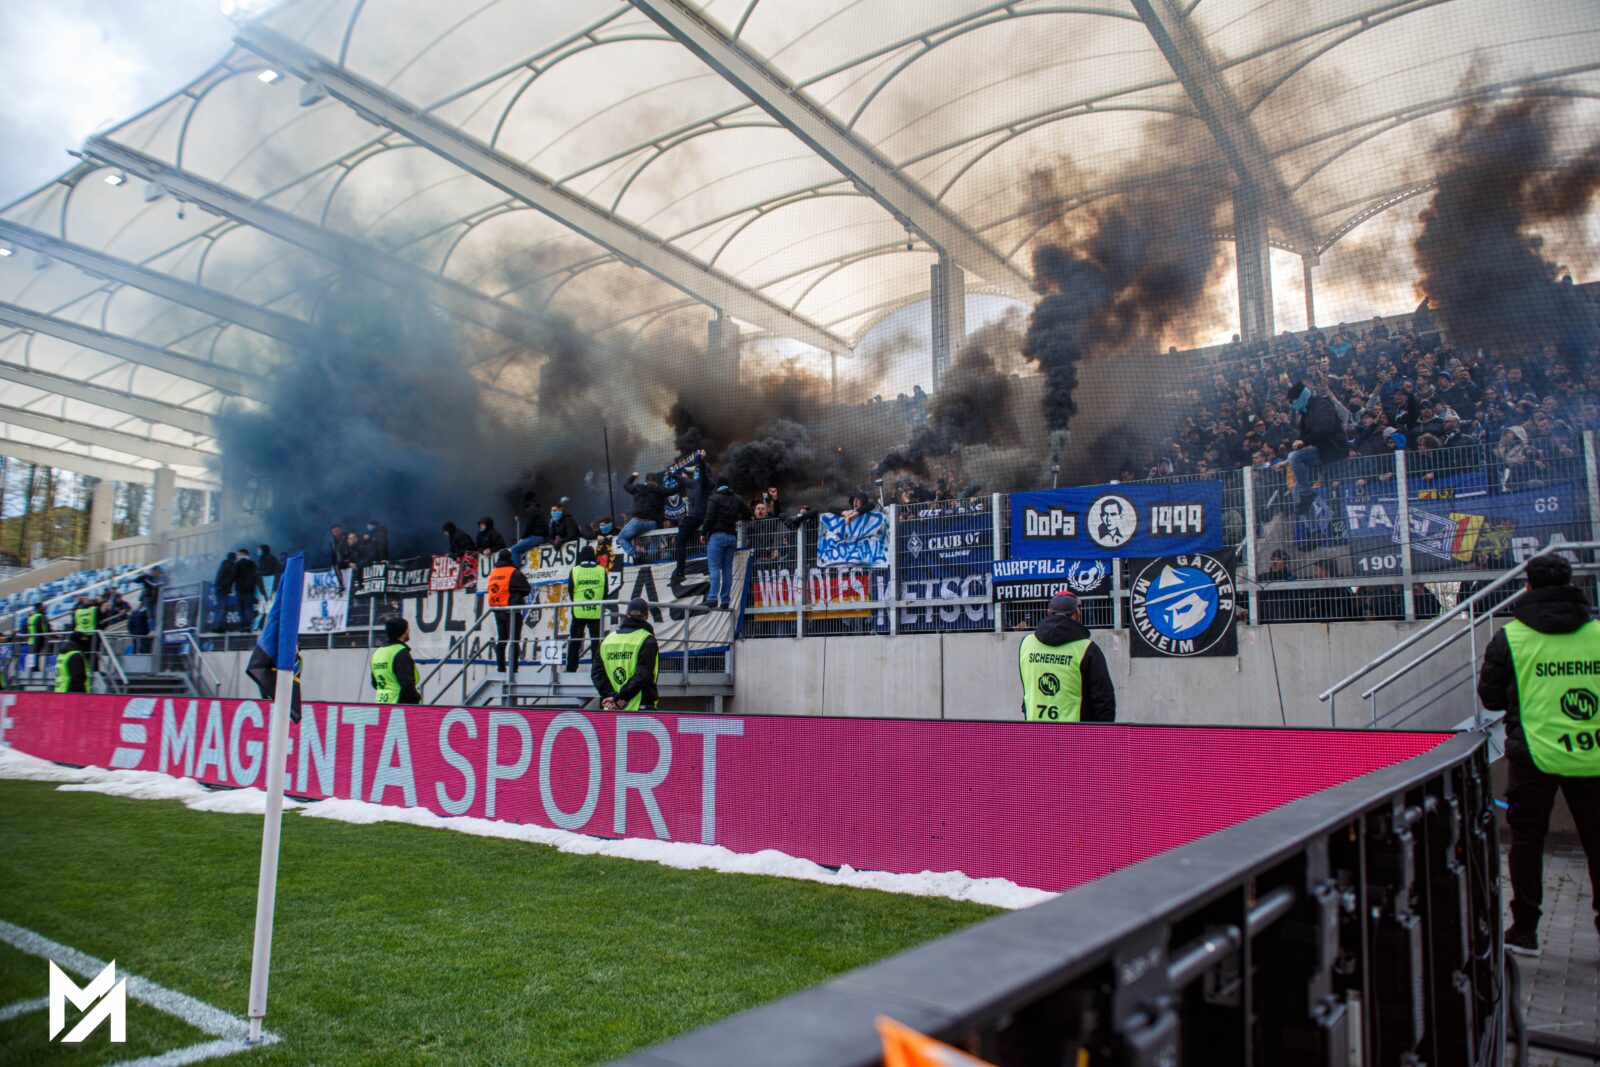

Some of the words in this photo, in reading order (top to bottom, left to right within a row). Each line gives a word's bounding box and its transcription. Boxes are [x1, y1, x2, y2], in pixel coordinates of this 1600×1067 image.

[1026, 508, 1076, 536] DoPa
[1152, 504, 1202, 534] 1999
[927, 534, 962, 550] CLUB
[965, 532, 981, 546] 07
[993, 559, 1066, 577] KURPFALZ
[1176, 555, 1233, 611] GAUNER
[1133, 578, 1194, 654] MANNHEIM
[544, 645, 560, 661] C2
[1029, 652, 1074, 666] SICHERHEIT
[1036, 704, 1060, 720] 76
[435, 708, 744, 845] SPORT
